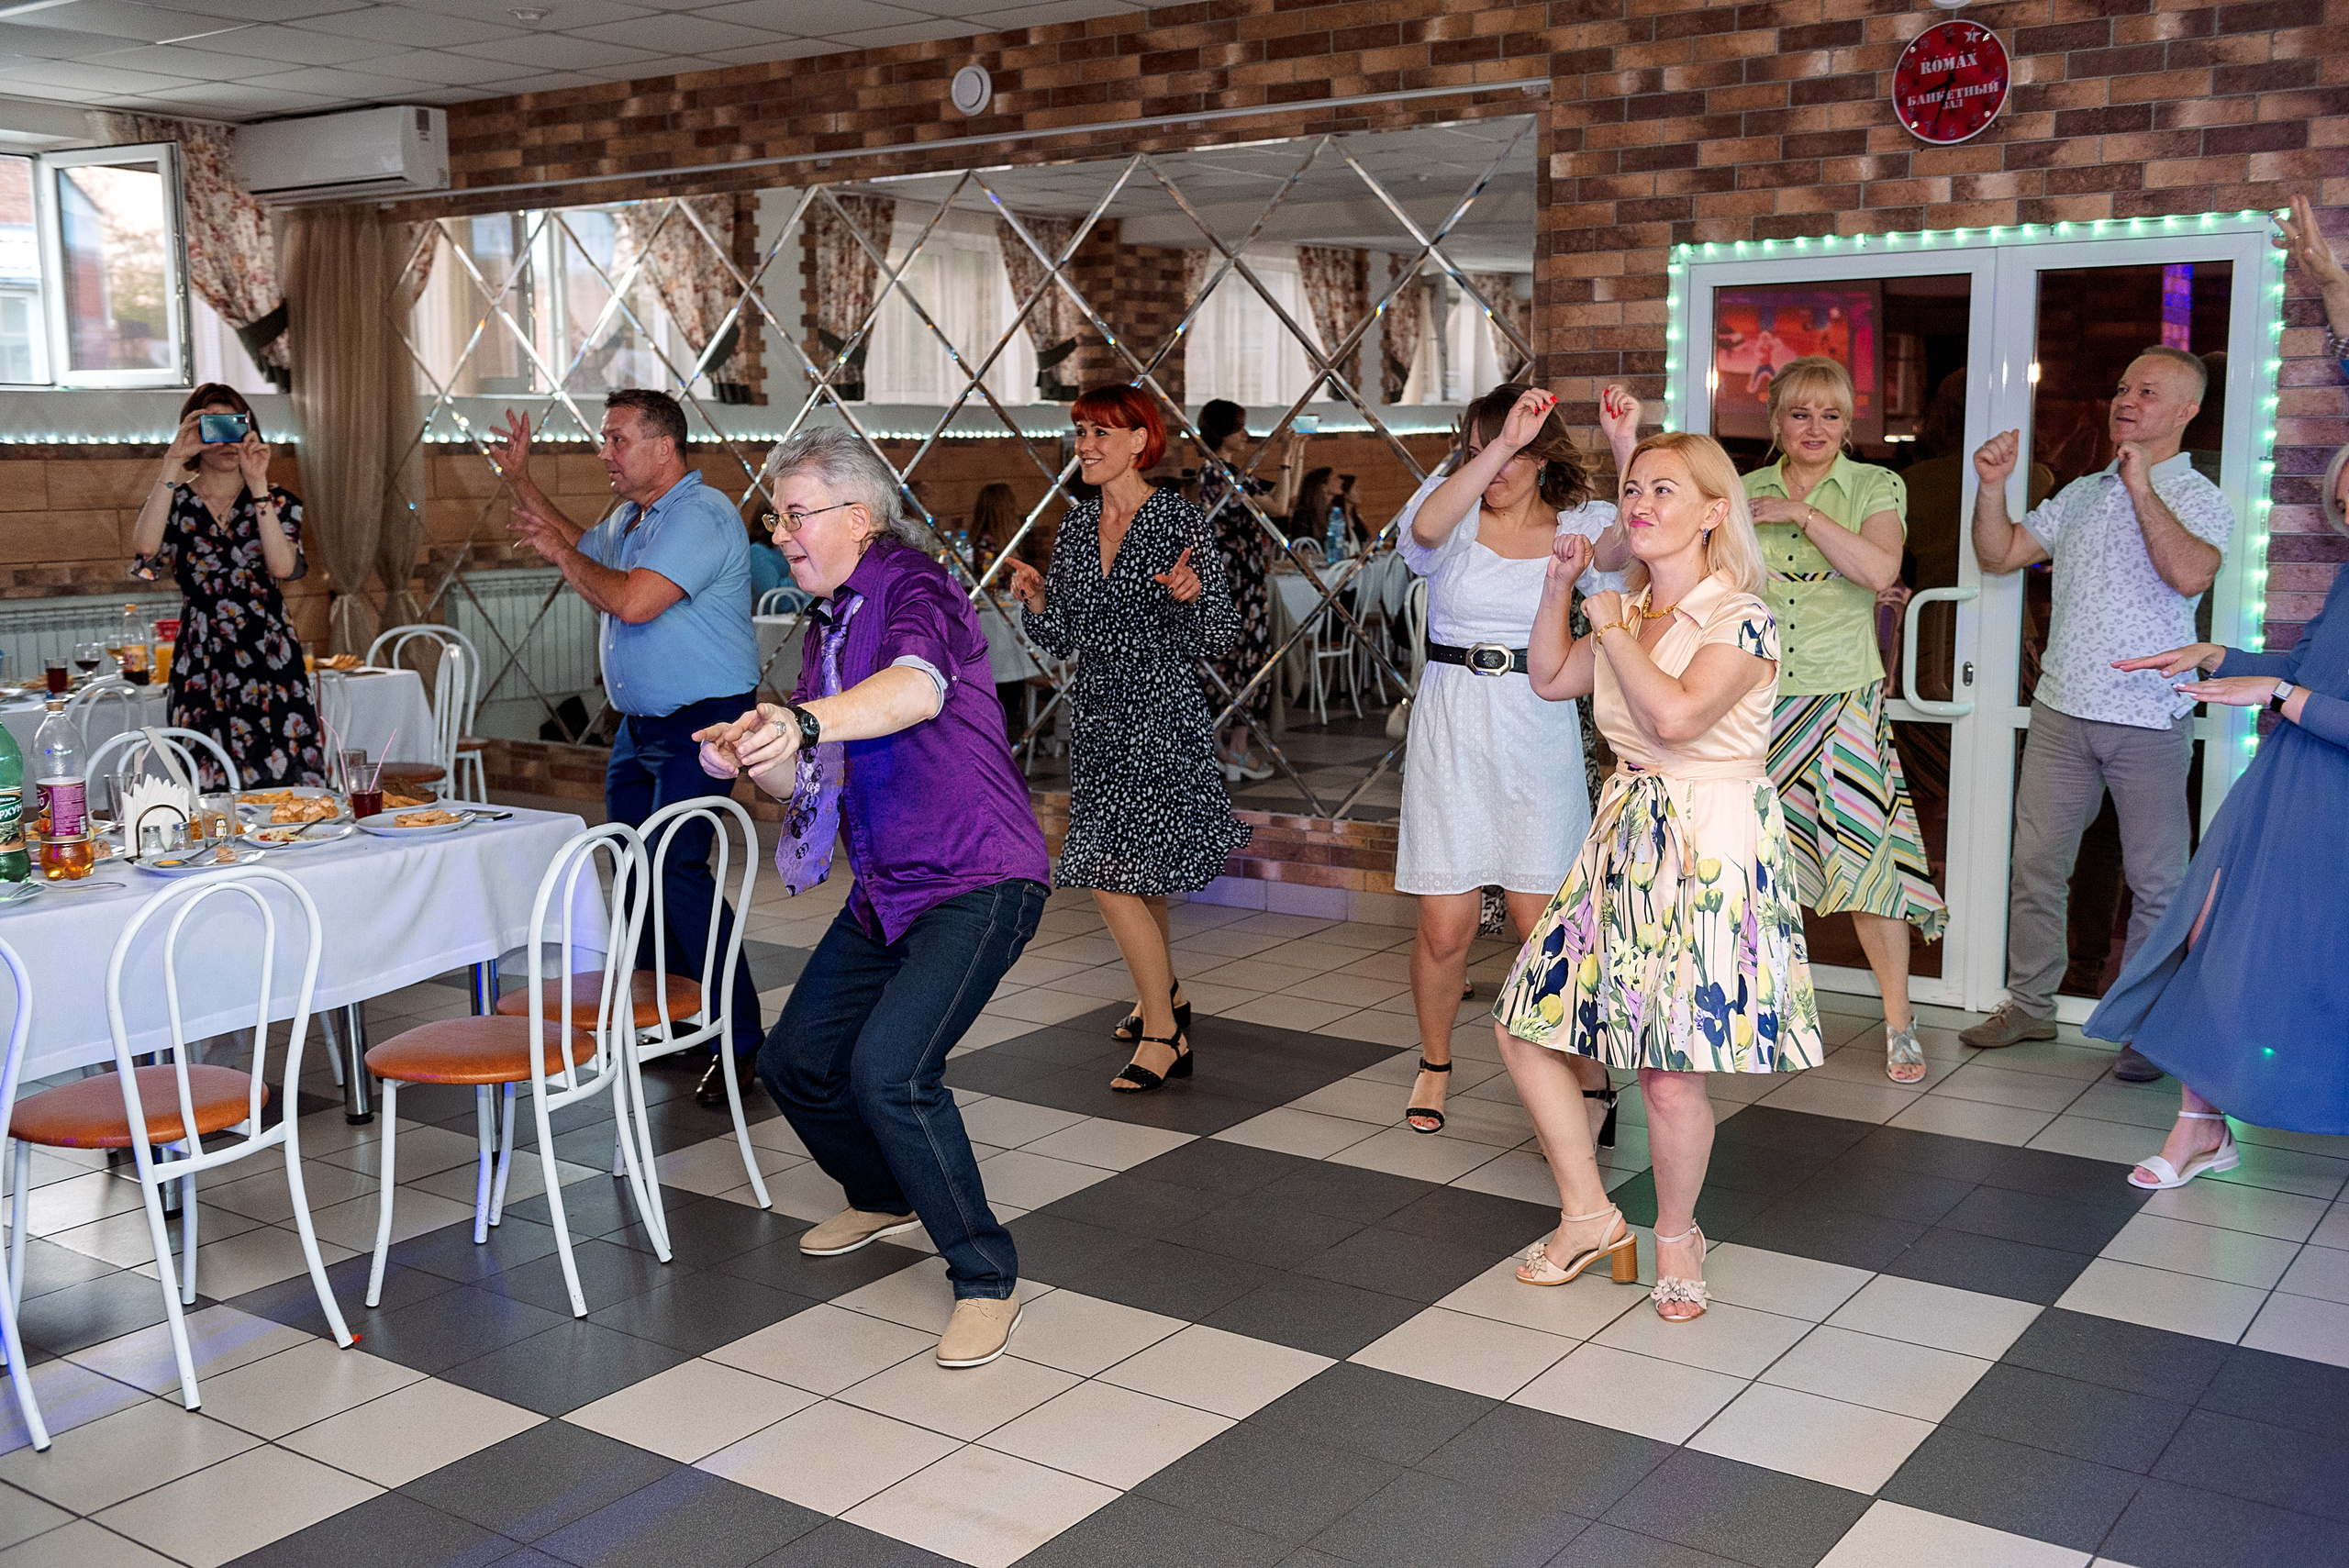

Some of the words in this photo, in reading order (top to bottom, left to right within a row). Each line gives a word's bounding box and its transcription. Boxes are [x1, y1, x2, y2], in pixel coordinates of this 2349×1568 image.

[1969, 28, 1975, 39] 1
[1920, 52, 1978, 75] ROMAX
[1907, 80, 1999, 107] БАНКЕТНЫЙ
[1942, 98, 1964, 110] ЗАЛ
